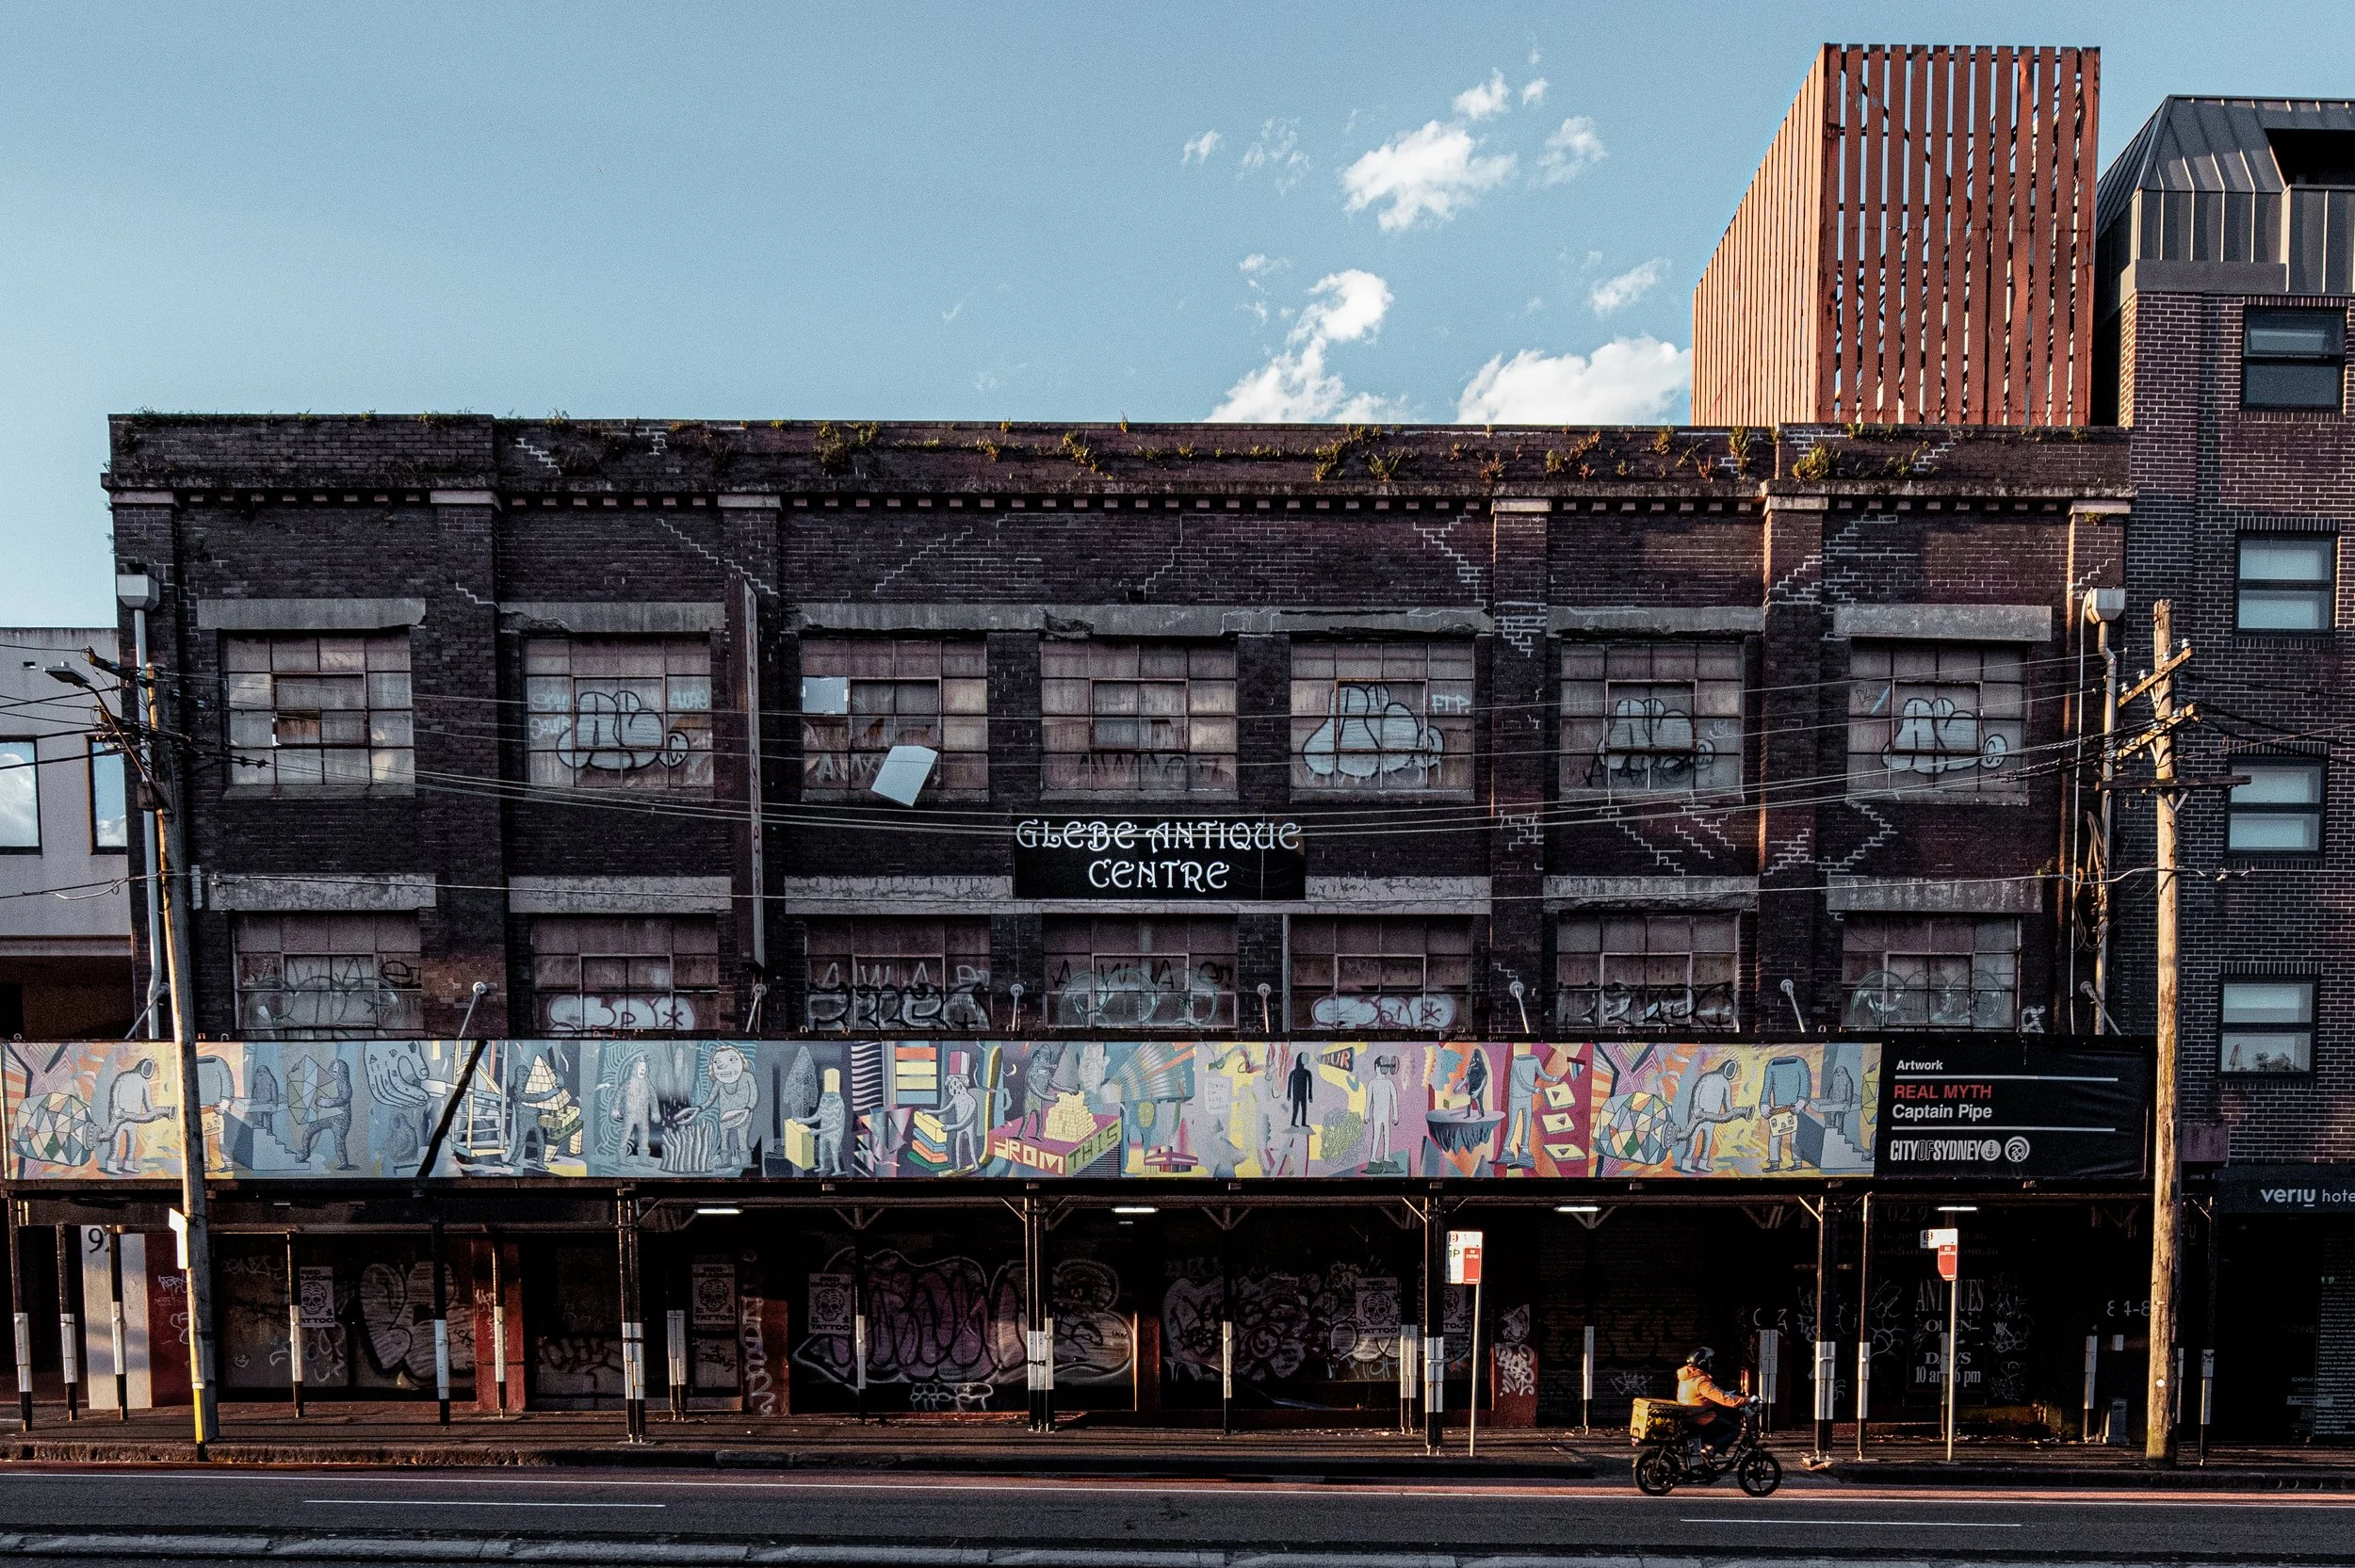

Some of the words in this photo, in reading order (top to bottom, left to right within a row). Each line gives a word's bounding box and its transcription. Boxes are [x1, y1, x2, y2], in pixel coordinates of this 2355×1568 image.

[1015, 818, 1139, 852] GLEBE
[1145, 819, 1302, 854] ANTIQUE
[1088, 859, 1230, 893] CENTRE
[1895, 1059, 1943, 1071] Artwork
[1893, 1084, 1939, 1099] REAL
[1943, 1084, 1993, 1100] MYTH
[1892, 1104, 1953, 1123] Captain
[1958, 1104, 1992, 1122] Pipe
[1068, 1123, 1118, 1169] THIS
[2260, 1188, 2316, 1207] veriu
[88, 1227, 110, 1253] 9
[1915, 1279, 1985, 1312] ANTUES
[1915, 1366, 1926, 1382] 10
[1964, 1370, 1981, 1387] pm
